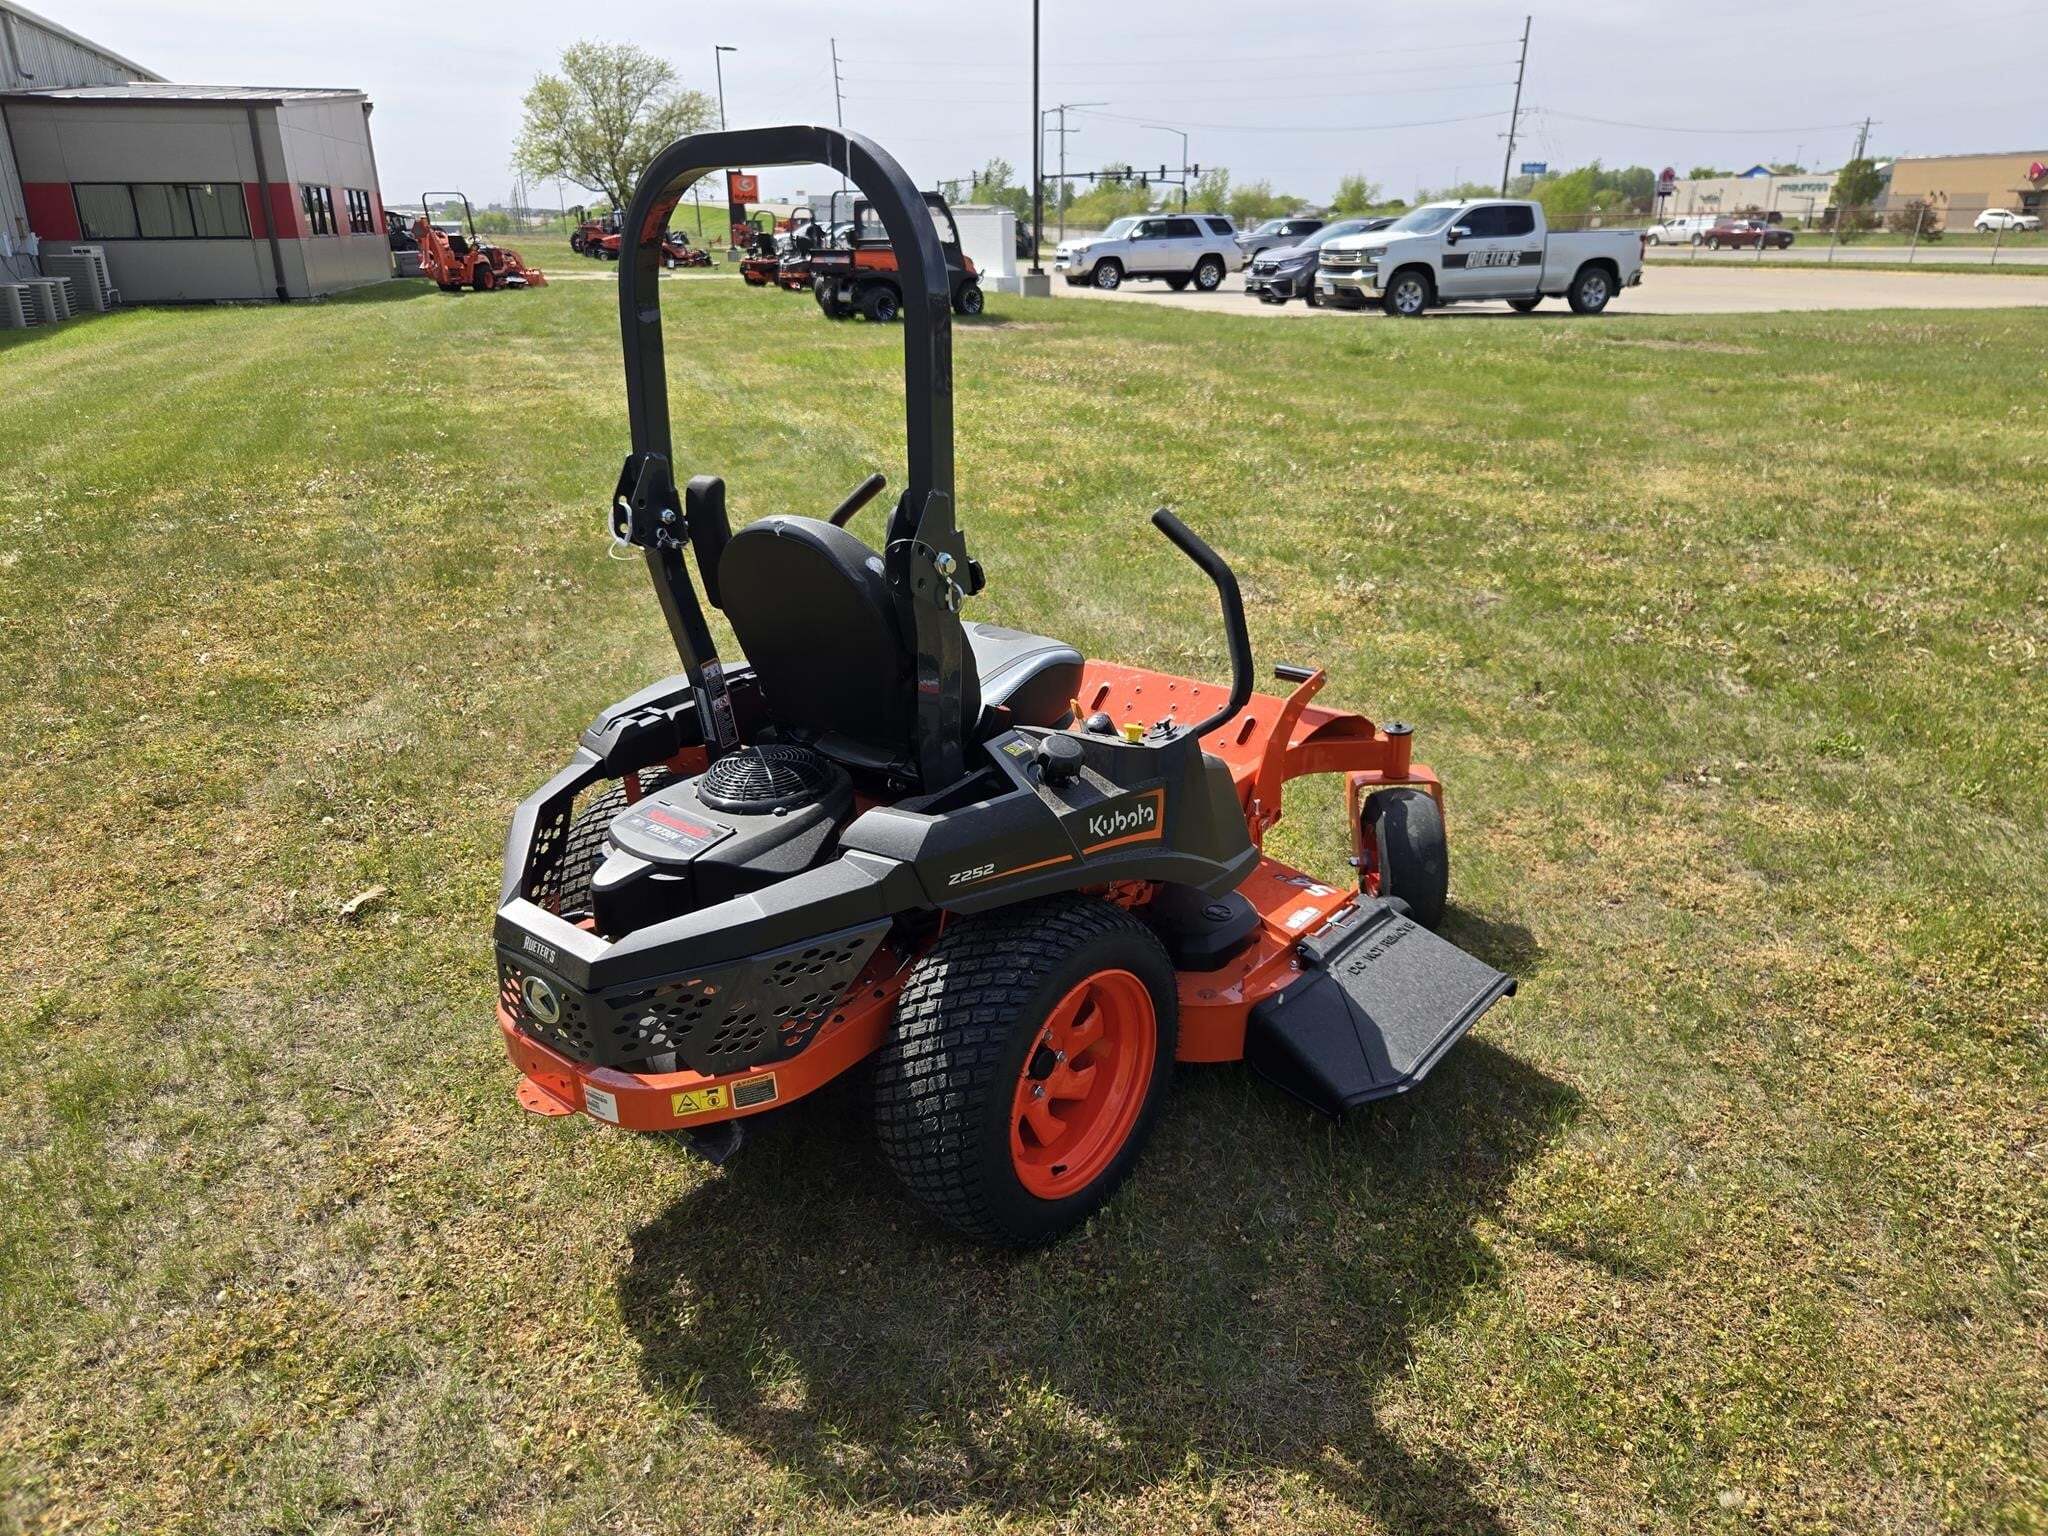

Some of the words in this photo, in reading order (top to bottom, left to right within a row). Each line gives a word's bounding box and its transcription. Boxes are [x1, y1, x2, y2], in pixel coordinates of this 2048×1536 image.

[1465, 250, 1522, 269] RUETER'S
[1089, 803, 1154, 837] Kubota
[948, 863, 995, 886] Z252
[523, 935, 556, 964] RUETER'S
